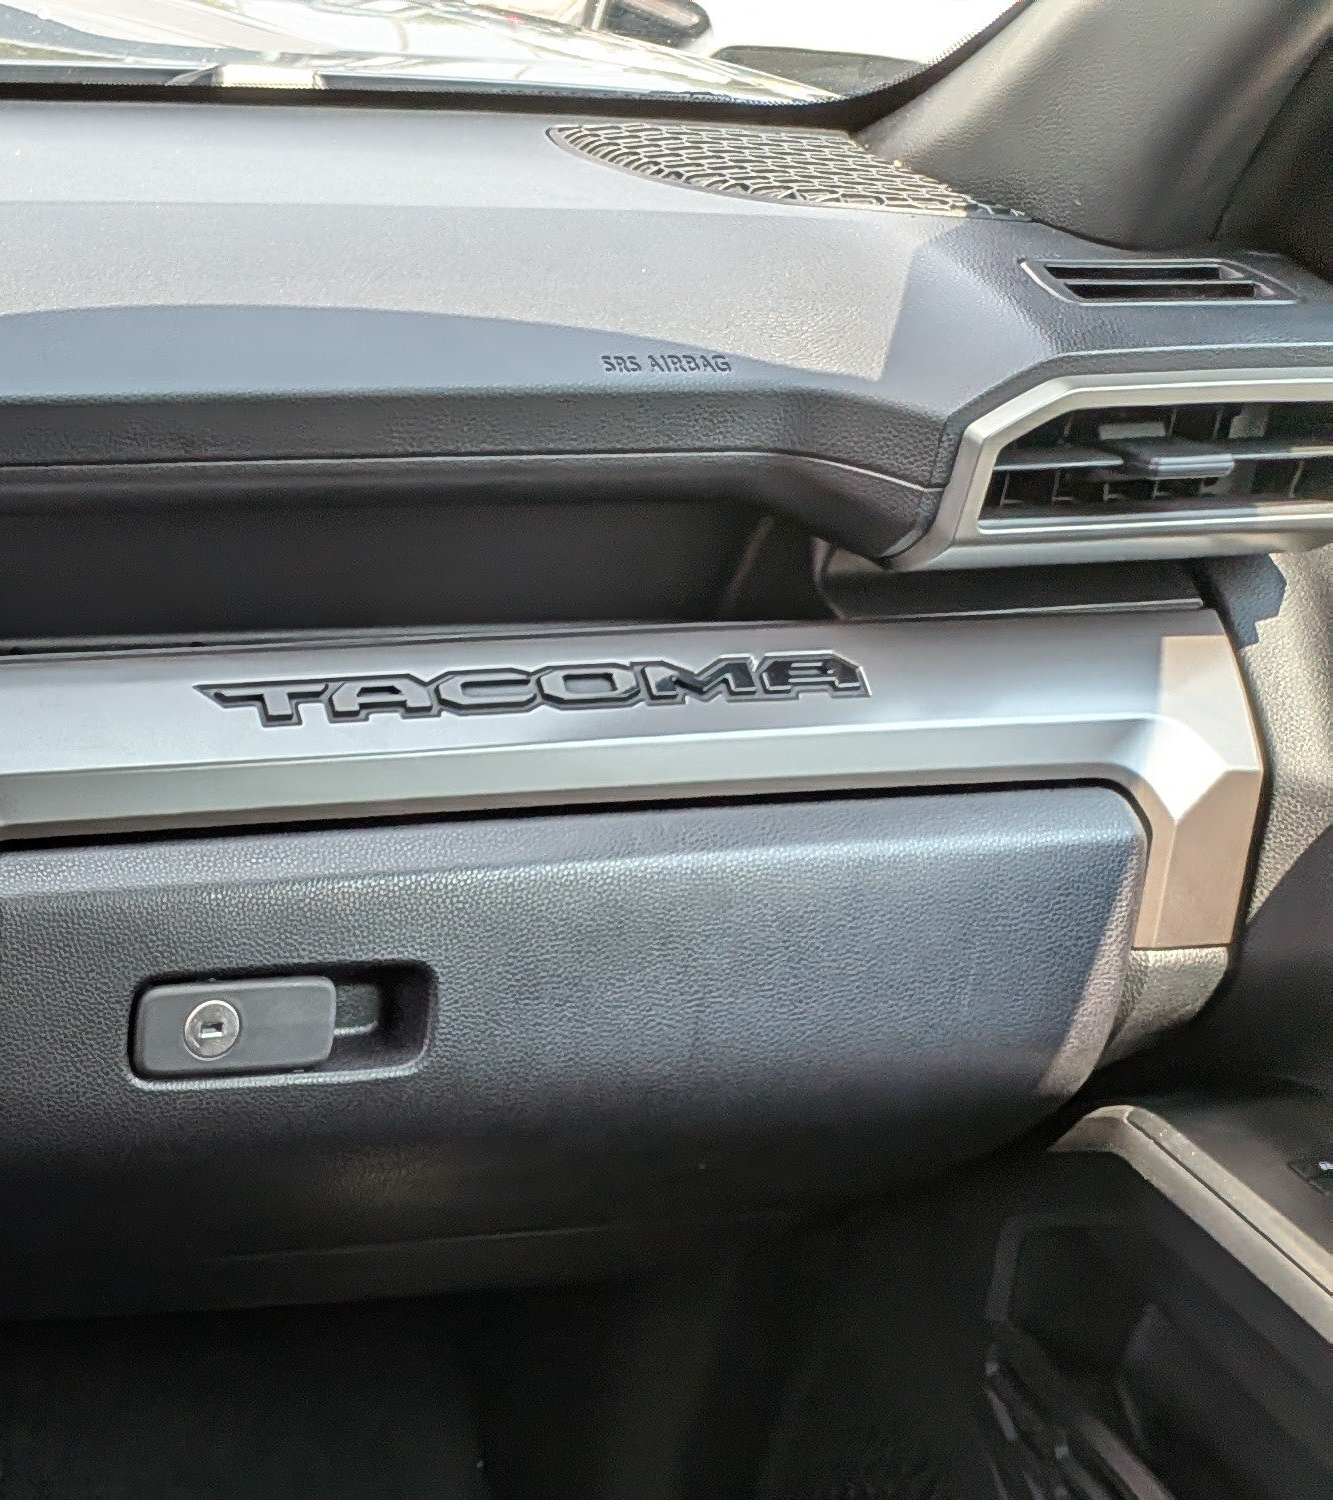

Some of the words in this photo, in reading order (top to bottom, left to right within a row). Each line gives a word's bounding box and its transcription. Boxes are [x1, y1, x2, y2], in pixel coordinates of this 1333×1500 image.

[601, 354, 642, 373] SRS
[647, 354, 732, 373] AIRBAG
[193, 650, 873, 727] TACOMA
